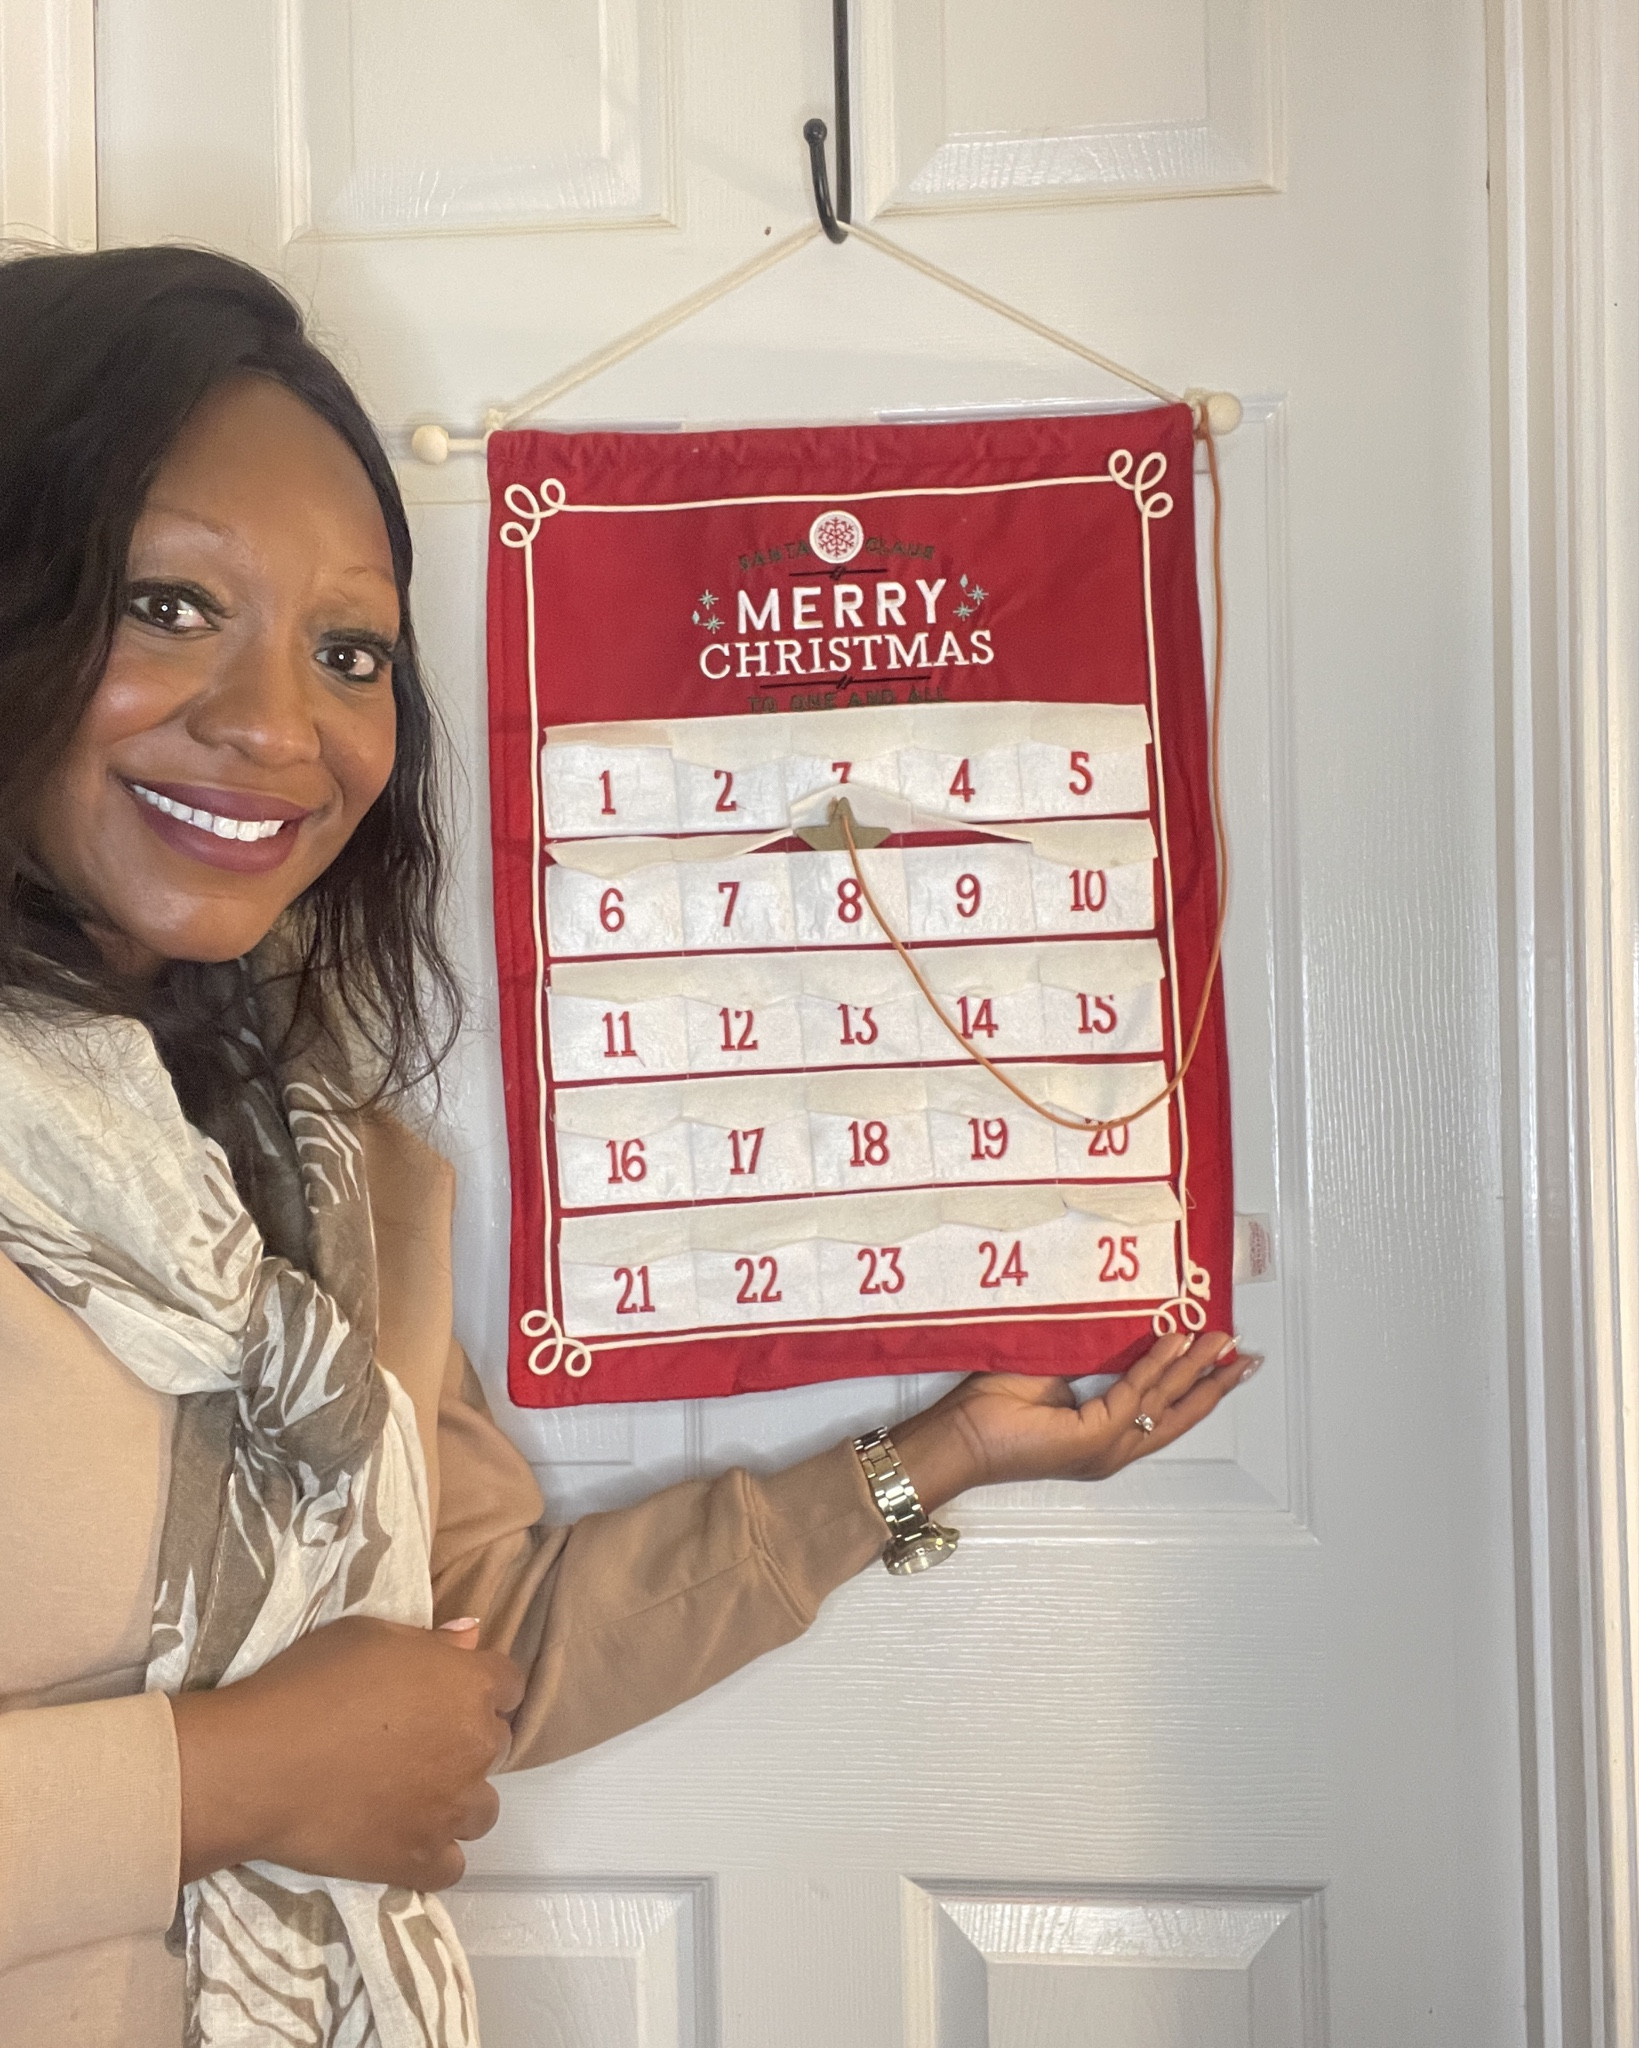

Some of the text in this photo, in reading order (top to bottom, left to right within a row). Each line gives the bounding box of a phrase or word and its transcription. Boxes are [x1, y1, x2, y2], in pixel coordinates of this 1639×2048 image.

[738, 538, 809, 570] SANTA
[737, 578, 947, 634] MERRY
[699, 630, 995, 680] CHRISTMAS
[748, 696, 776, 714] TO
[849, 688, 896, 708] AND
[599, 770, 617, 815] 1
[714, 770, 737, 813] 2
[948, 758, 975, 803] 4
[1069, 750, 1094, 796] 5
[599, 868, 1107, 933] 6 7 8 9 10
[602, 992, 1117, 1059] 11 12 13 14 15
[606, 1138, 647, 1186] 16
[727, 1127, 765, 1176] 17
[848, 1119, 891, 1168] 18
[968, 1117, 1009, 1162] 19
[613, 1234, 1141, 1315] 21 22 23 24 25
